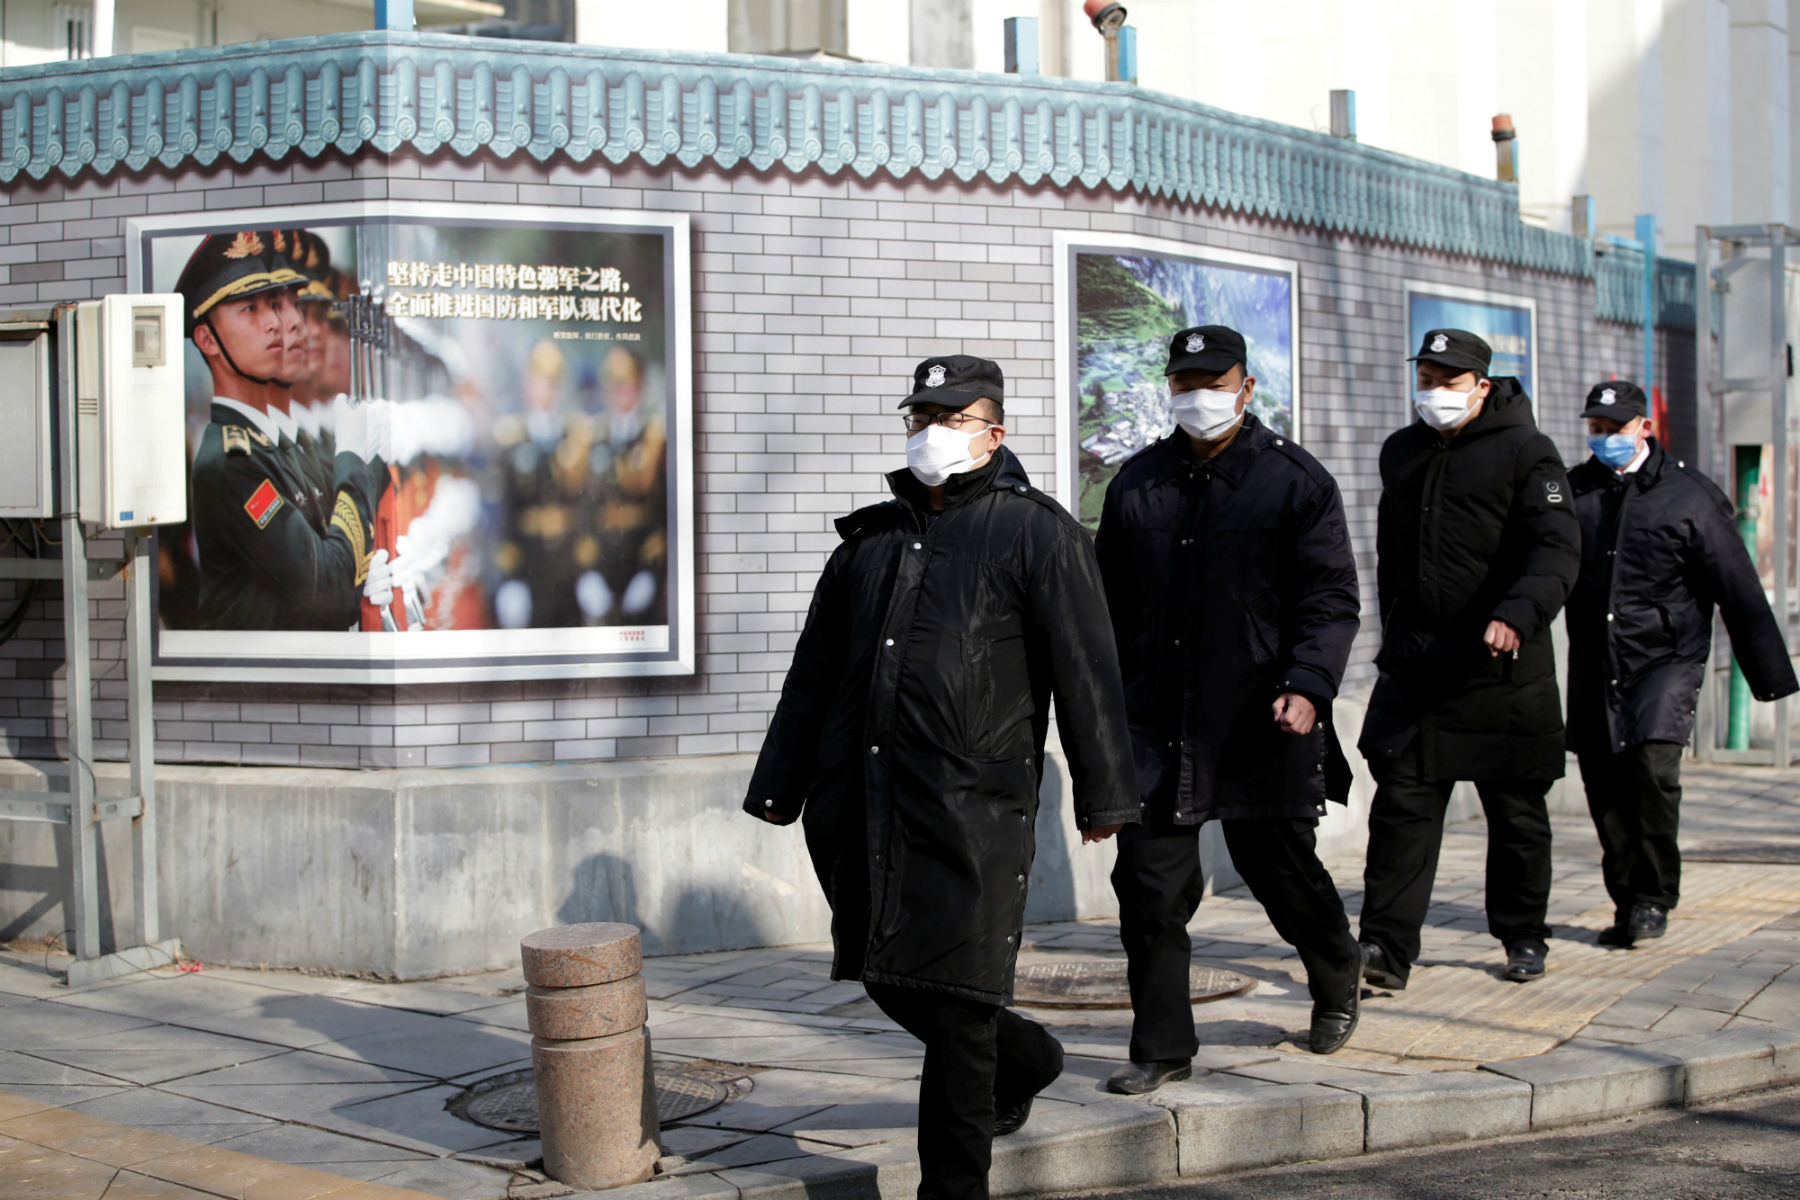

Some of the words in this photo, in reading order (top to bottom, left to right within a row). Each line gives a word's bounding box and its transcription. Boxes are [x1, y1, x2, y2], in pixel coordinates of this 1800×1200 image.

[387, 261, 630, 293] 坚持走中国特色强军之路，
[387, 292, 643, 321] 全面推进国防和军队现代化
